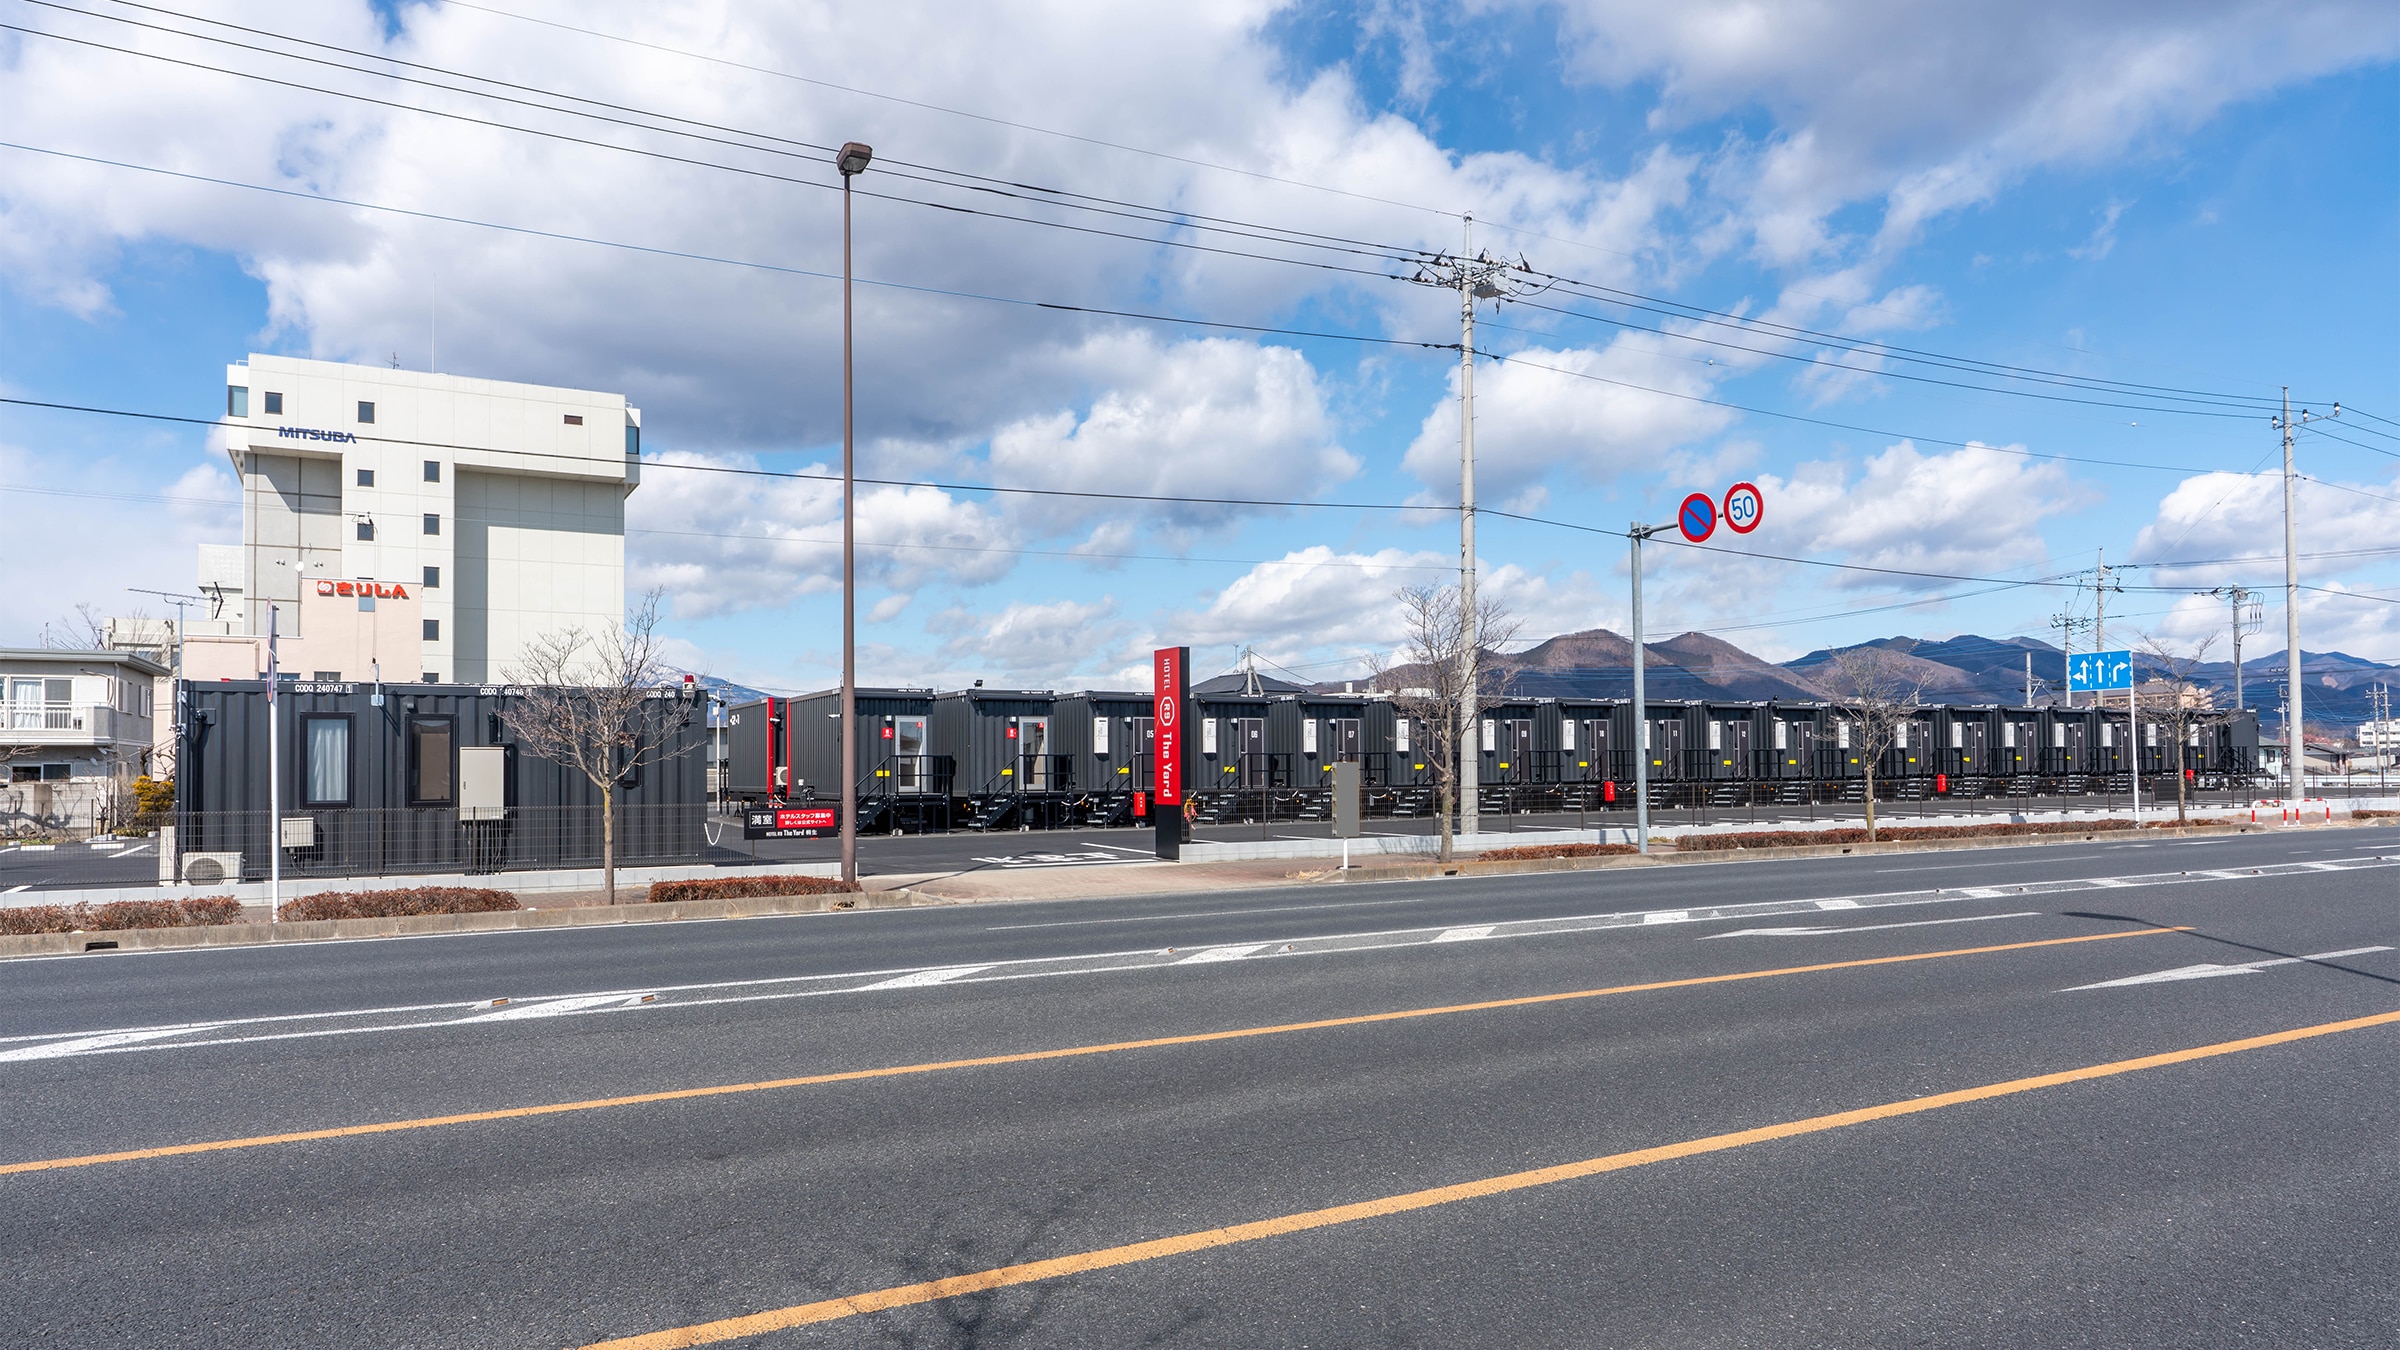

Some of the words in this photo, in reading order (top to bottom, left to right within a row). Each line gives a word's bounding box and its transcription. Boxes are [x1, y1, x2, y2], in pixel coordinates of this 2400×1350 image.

[279, 426, 357, 444] MITSUBA
[1731, 495, 1755, 521] 50
[336, 581, 410, 600] きりしん
[1163, 658, 1171, 691] HOTEL
[316, 684, 343, 693] 240747
[1146, 730, 1154, 738] 05
[1347, 730, 1355, 738] 07
[1162, 731, 1173, 759] The
[1162, 762, 1173, 798] Yard
[751, 814, 773, 826] 満室
[783, 829, 793, 837] The
